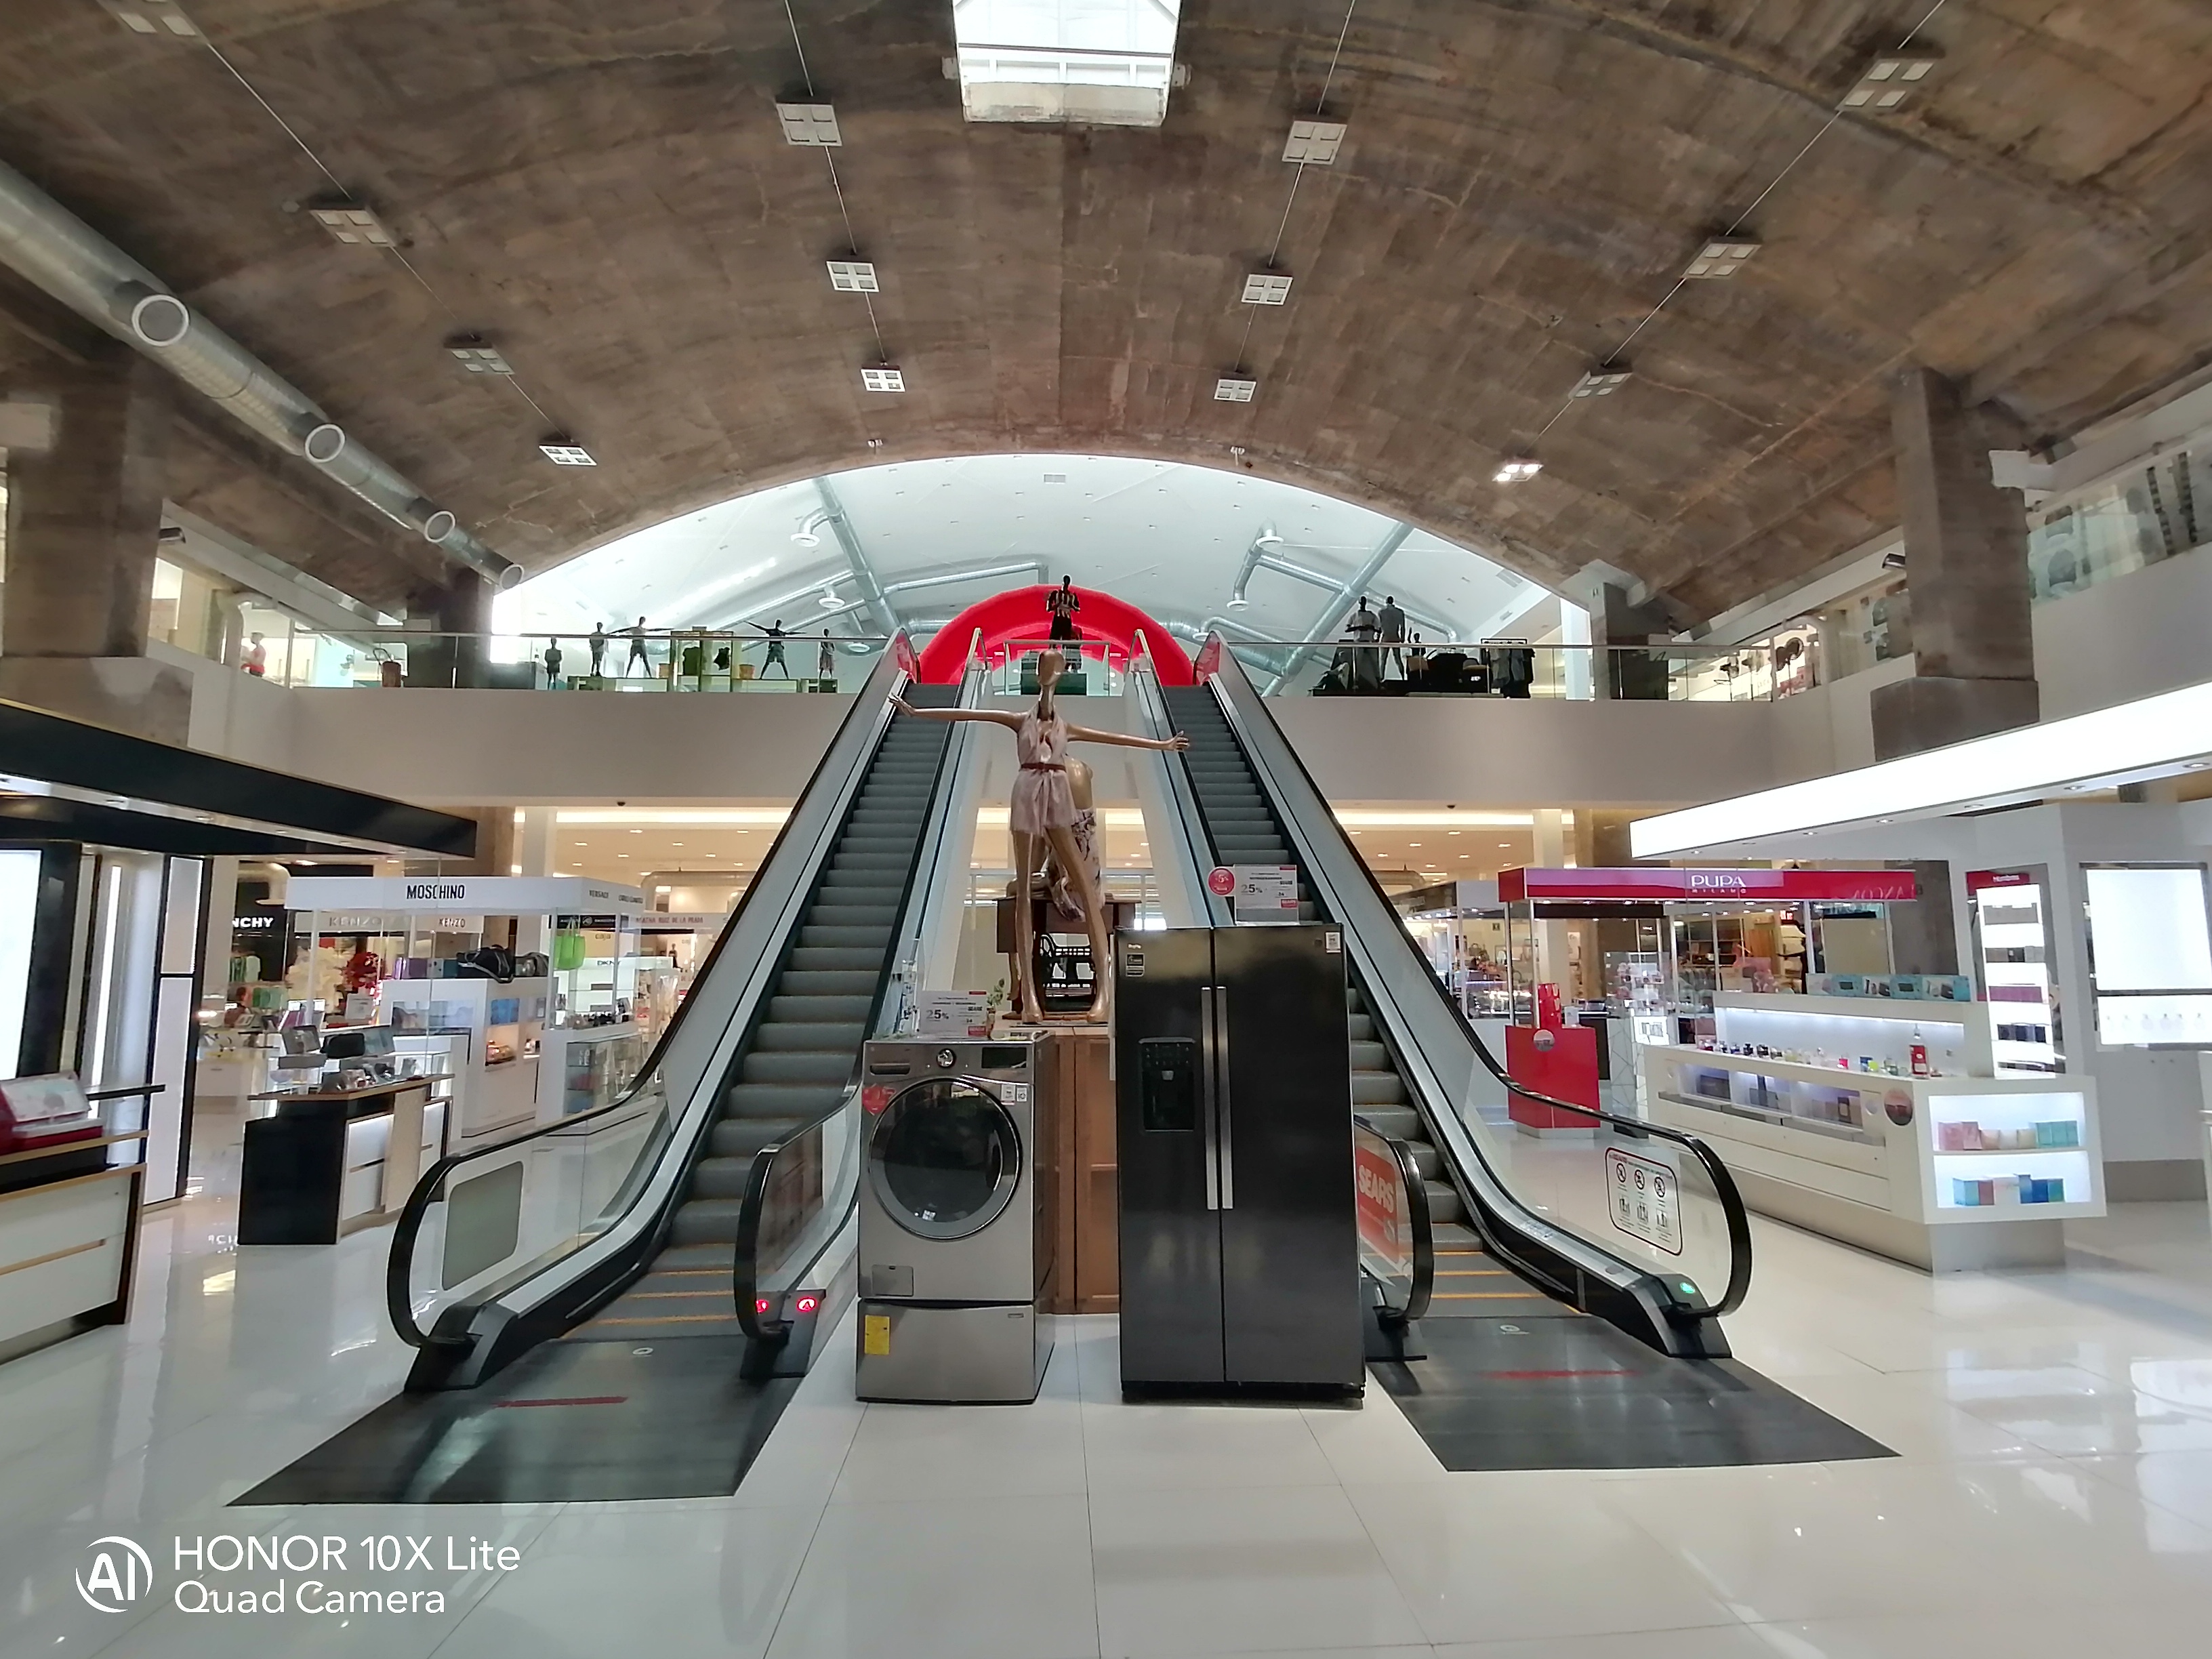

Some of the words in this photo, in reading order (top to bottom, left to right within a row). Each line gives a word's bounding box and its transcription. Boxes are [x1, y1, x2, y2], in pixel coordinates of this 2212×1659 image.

[1691, 875, 1746, 887] PUPA
[407, 884, 465, 900] MOSCHINO
[438, 918, 466, 928] KENZO
[1358, 1164, 1394, 1213] SEARS
